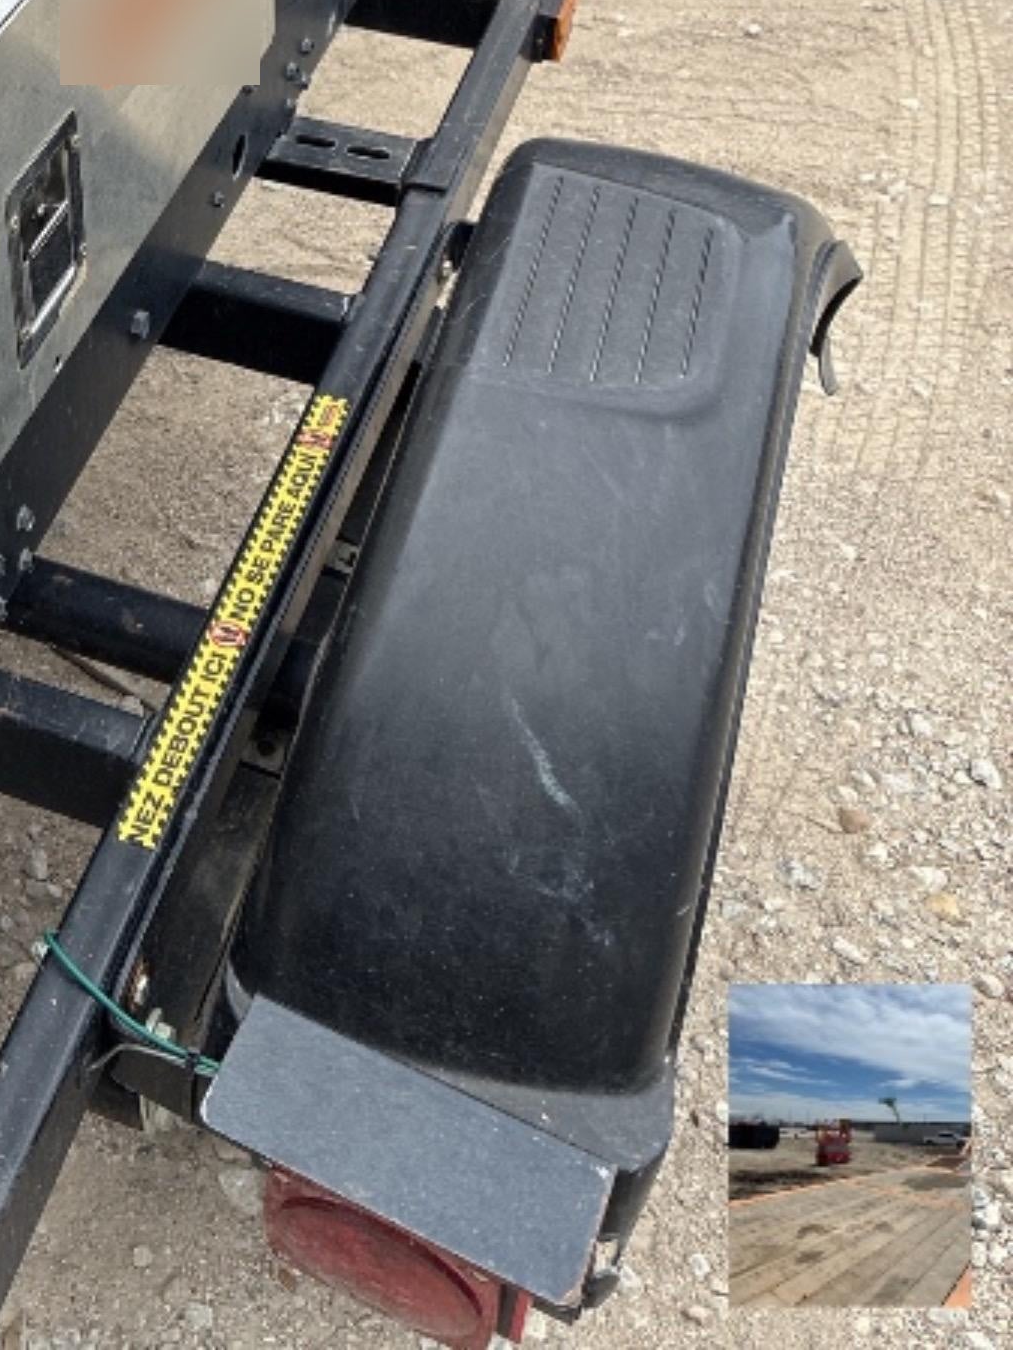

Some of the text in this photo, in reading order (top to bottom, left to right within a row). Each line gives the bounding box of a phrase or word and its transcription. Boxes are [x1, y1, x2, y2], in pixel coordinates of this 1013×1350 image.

[229, 586, 257, 622] NO
[246, 556, 272, 587] SE
[259, 501, 298, 555] PARE
[151, 685, 211, 788] DEBOUT
